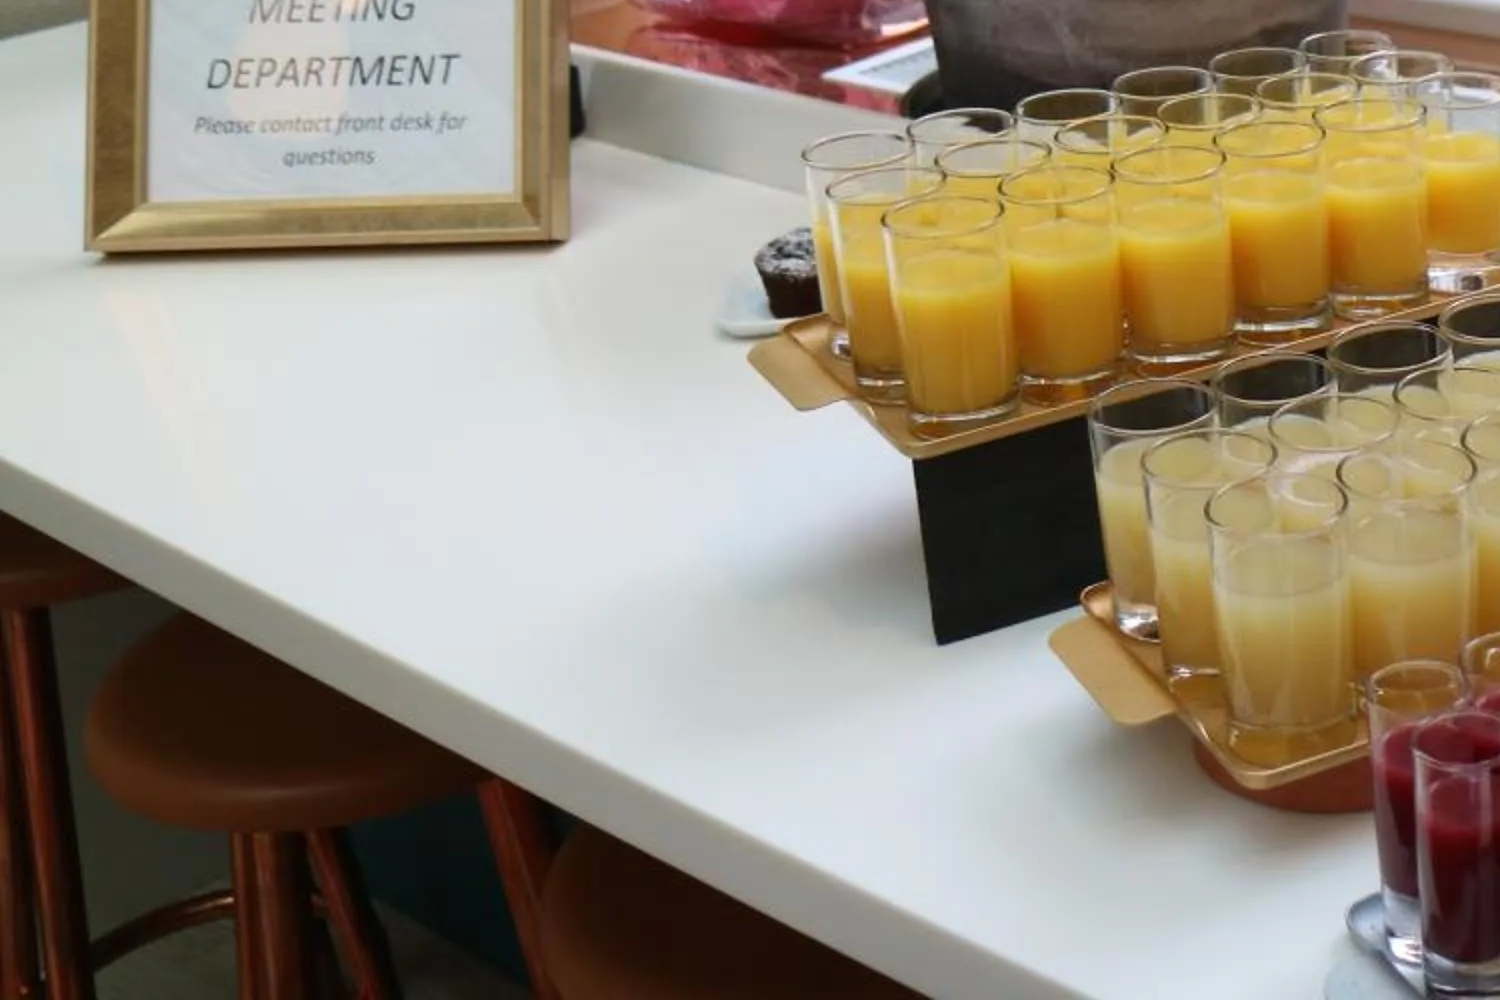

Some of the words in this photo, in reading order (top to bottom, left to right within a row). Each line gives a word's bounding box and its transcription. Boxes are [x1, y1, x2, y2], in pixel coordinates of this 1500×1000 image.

[206, 54, 462, 90] DEPARTMENT
[194, 116, 252, 135] Please
[260, 115, 333, 134] contact
[335, 112, 385, 137] front
[390, 111, 434, 132] desk
[434, 111, 468, 135] for
[282, 148, 376, 168] questions
